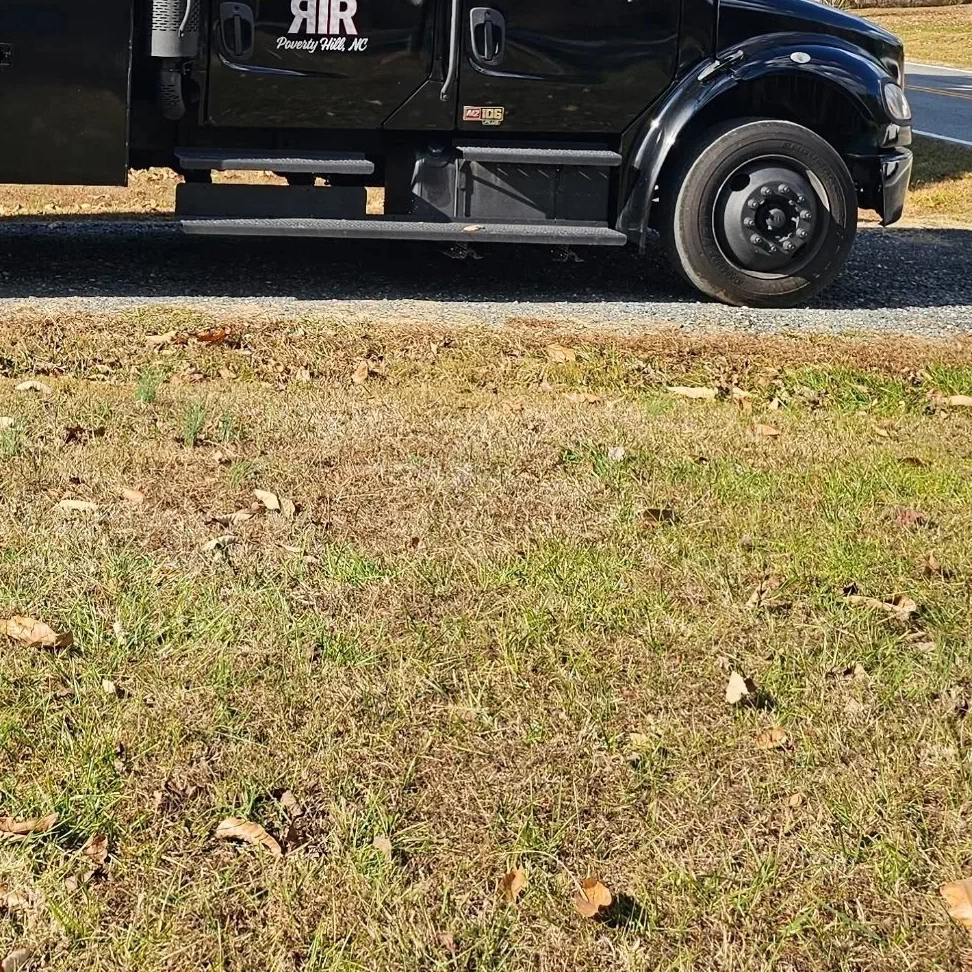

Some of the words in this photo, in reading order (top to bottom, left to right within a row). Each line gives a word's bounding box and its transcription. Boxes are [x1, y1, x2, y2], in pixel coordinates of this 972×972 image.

[276, 36, 319, 54] Poverty
[319, 37, 346, 52] Hill,
[347, 38, 369, 52] NC
[481, 108, 502, 119] 106
